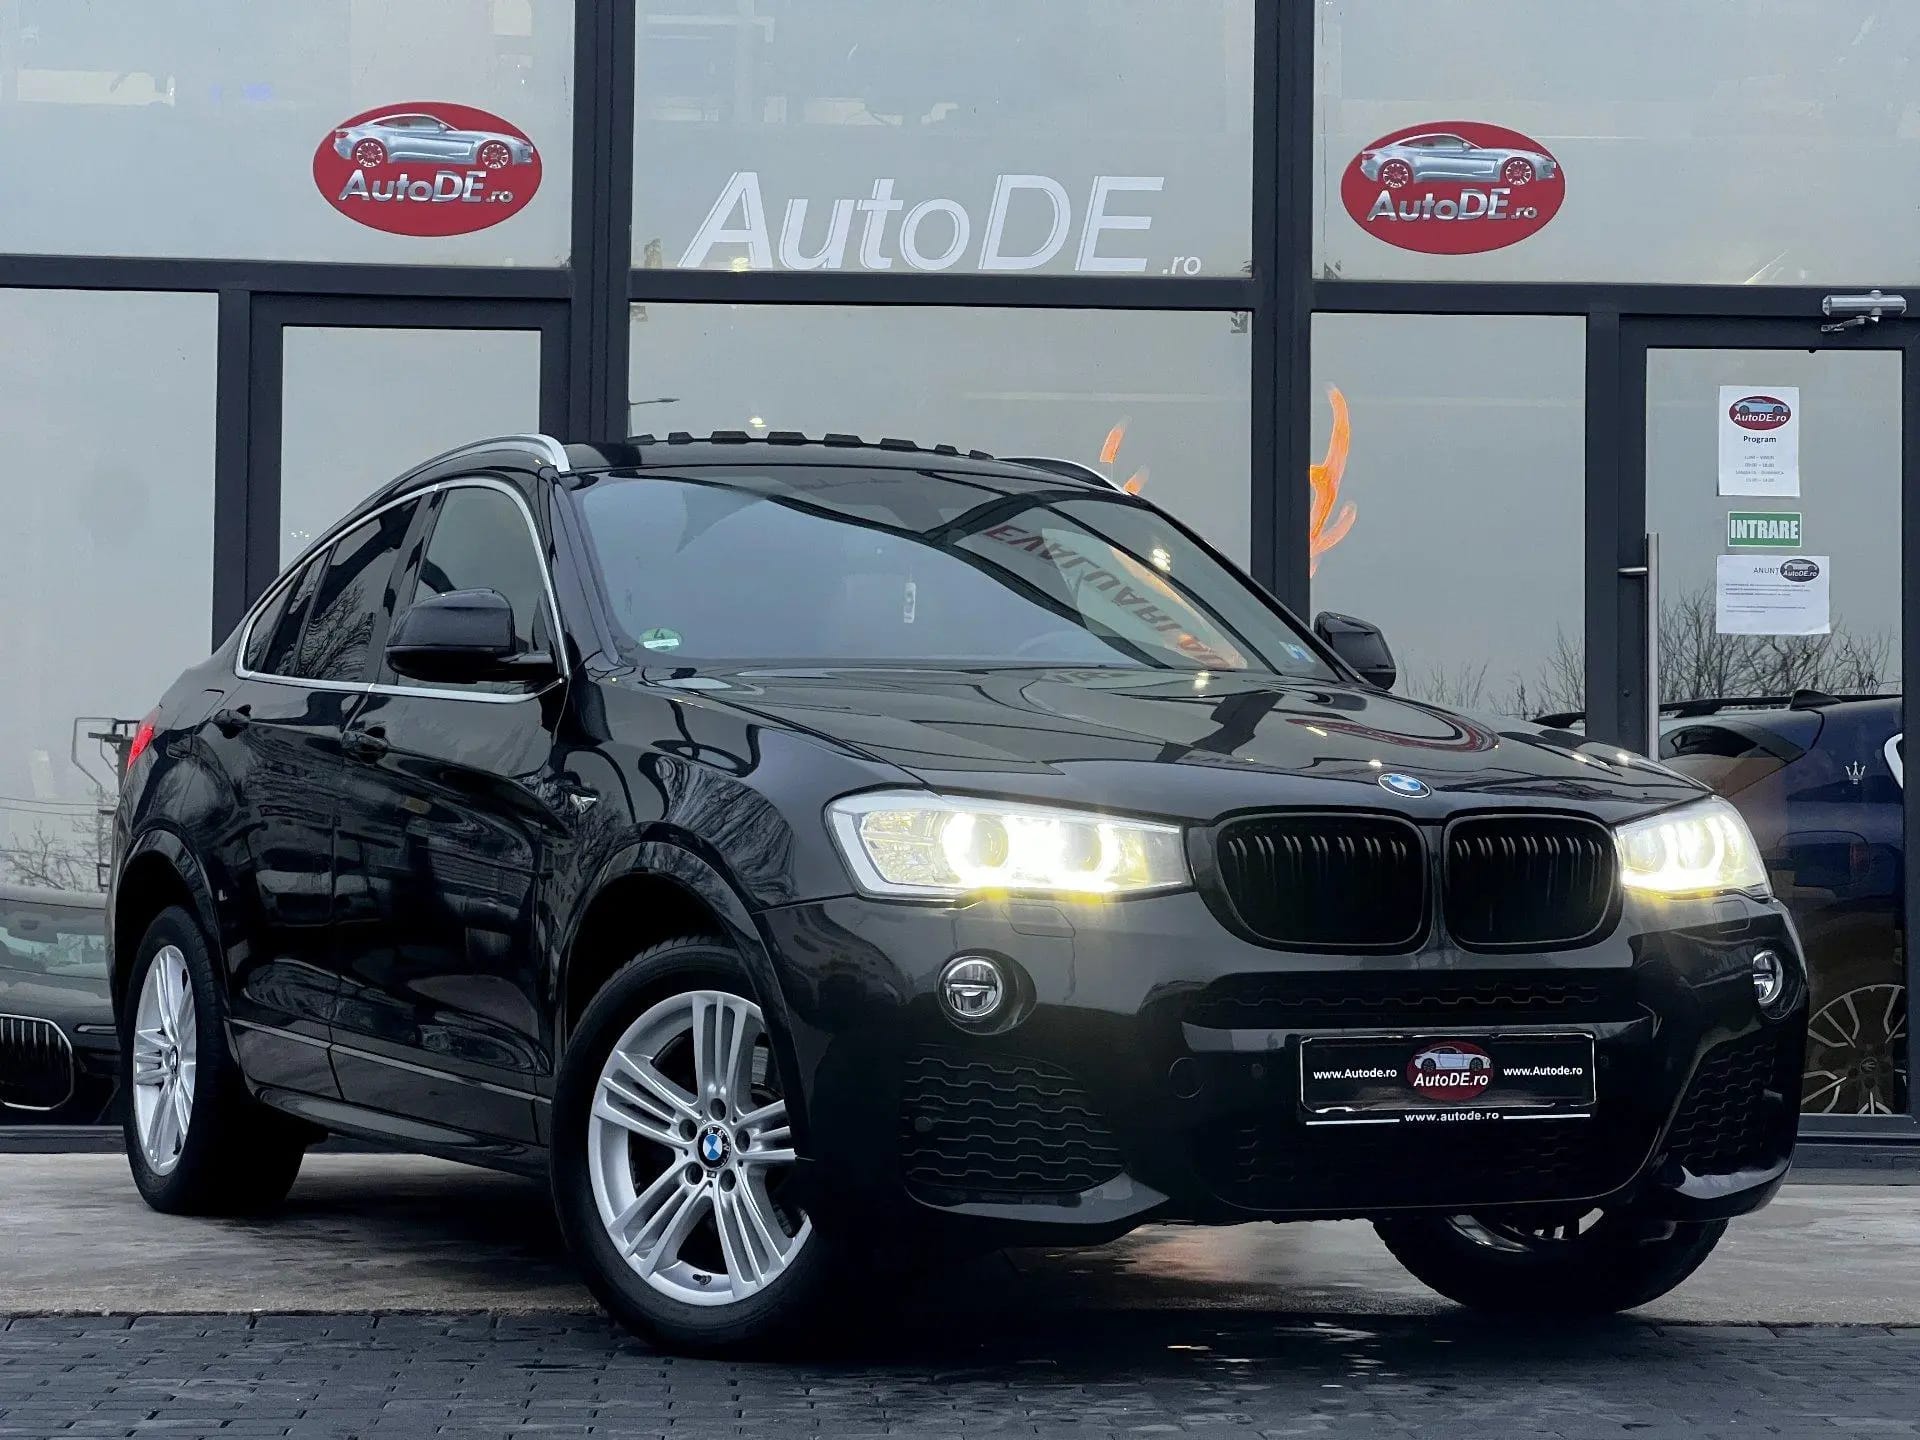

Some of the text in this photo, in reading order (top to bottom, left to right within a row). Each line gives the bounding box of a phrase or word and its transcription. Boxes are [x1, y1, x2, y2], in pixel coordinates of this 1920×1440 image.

[338, 169, 514, 203] AutoDE.ro
[1366, 187, 1538, 222] AutoDE.ro
[1733, 413, 1787, 422] AutoDE.ro
[1743, 435, 1777, 444] Program
[1730, 519, 1799, 539] INTRARE
[1313, 1067, 1398, 1080] www.Autode.ro
[1503, 1065, 1584, 1077] www.Autode.ro
[1413, 1072, 1489, 1088] AutoDE.ro
[1404, 1110, 1500, 1123] www.autode.ro
